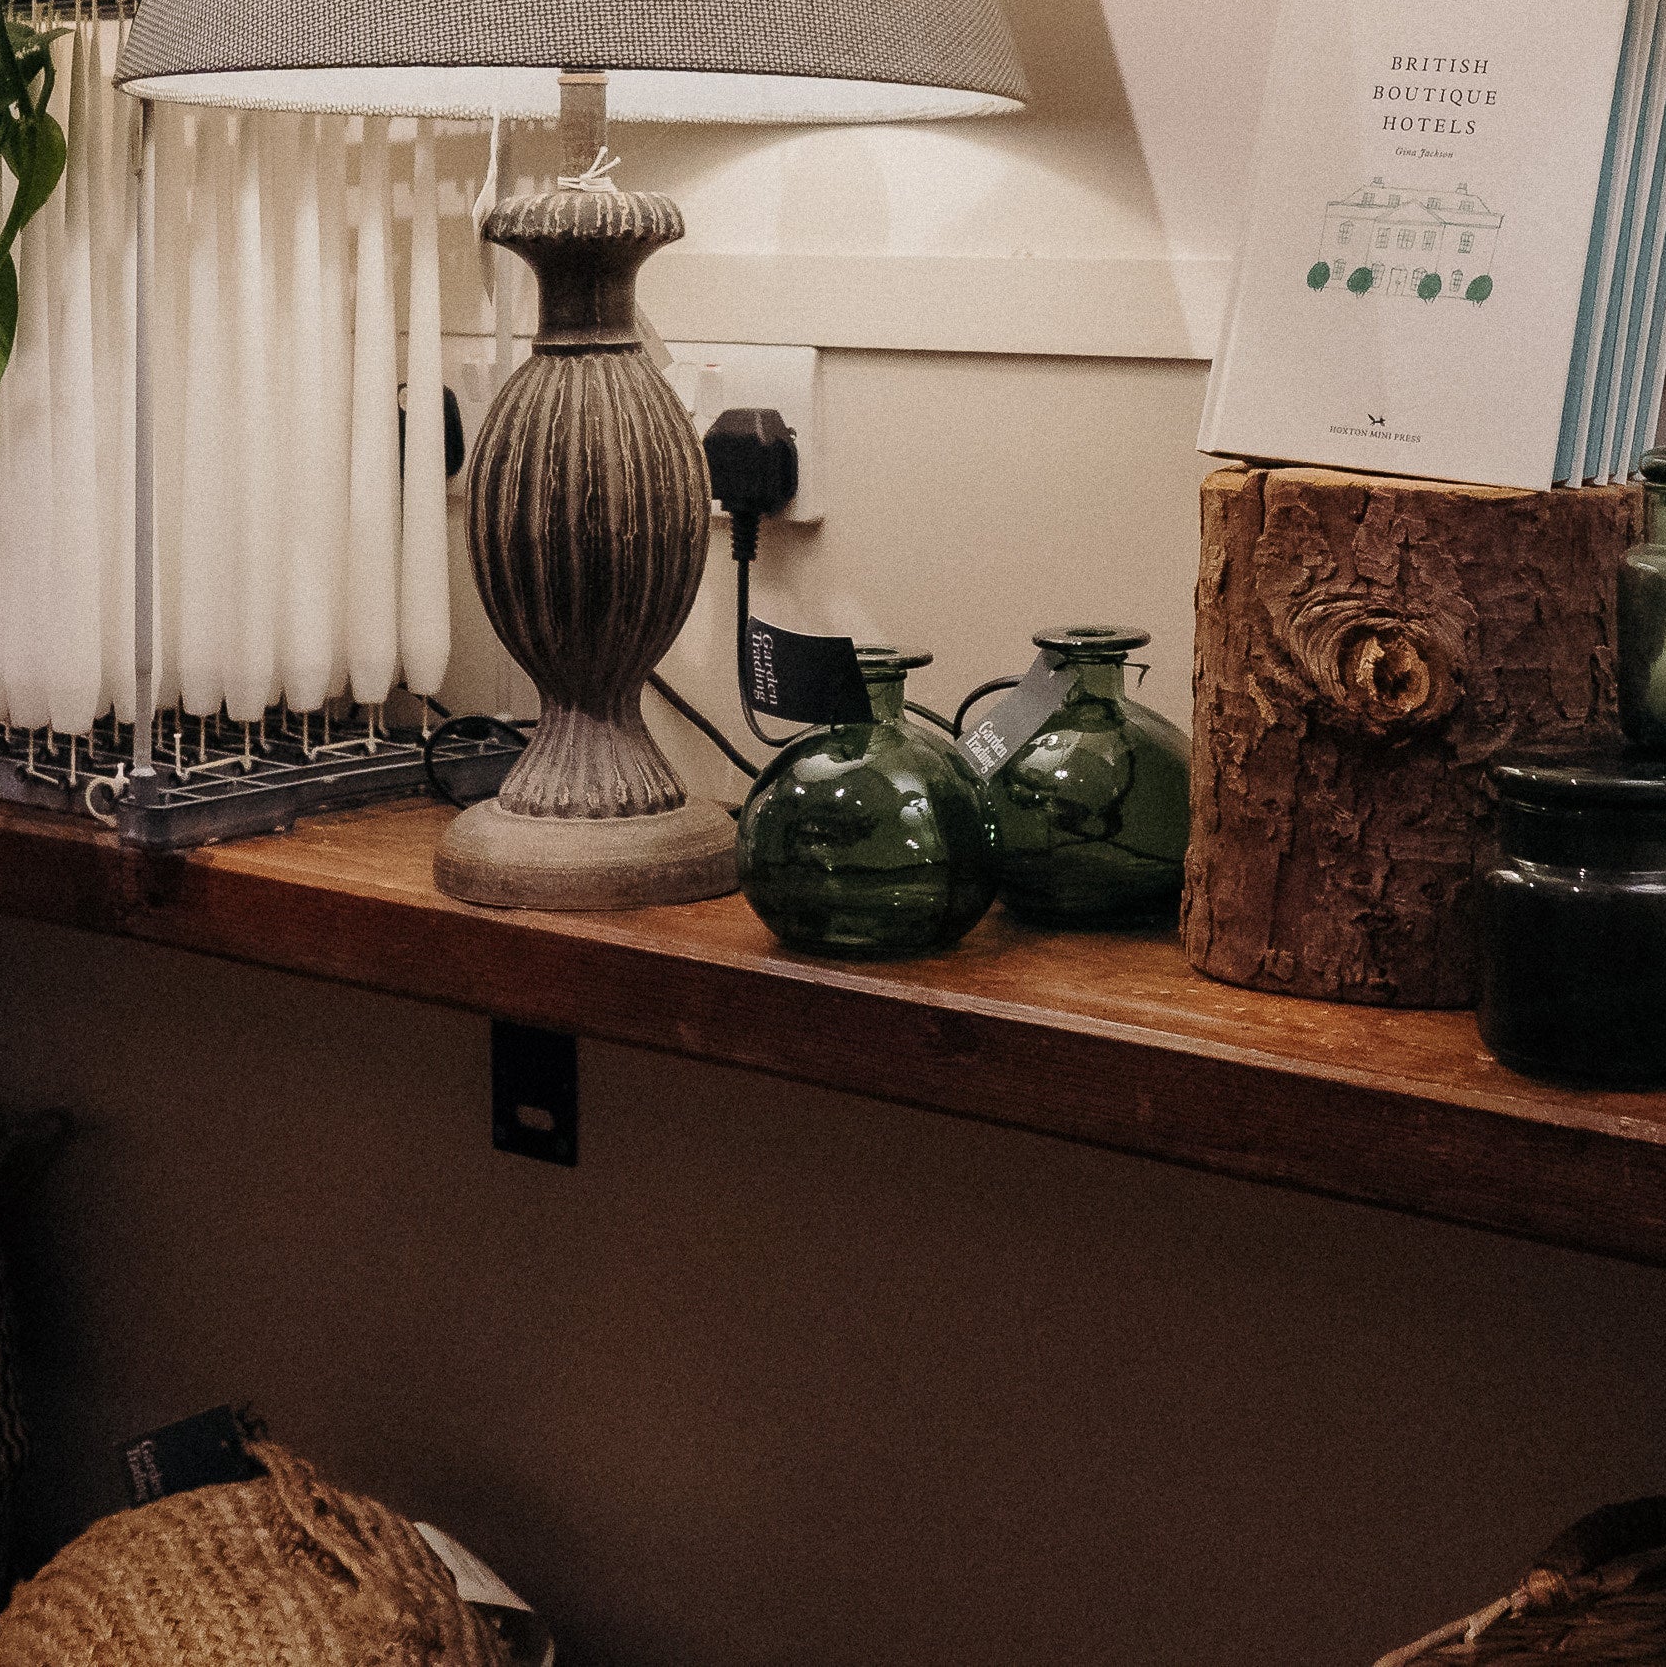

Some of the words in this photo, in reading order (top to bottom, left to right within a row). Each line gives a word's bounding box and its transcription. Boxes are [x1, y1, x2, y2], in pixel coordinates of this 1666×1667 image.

[1390, 56, 1489, 74] BRITISH
[1372, 85, 1498, 106] BOUTIQUE
[1382, 115, 1477, 135] HOTELS
[1395, 147, 1417, 157] Gina
[1418, 148, 1454, 159] Jackson
[1329, 425, 1368, 437] HOXTON
[1369, 430, 1392, 440] MINI
[1393, 433, 1422, 443] PRESS
[752, 631, 766, 703] Trading
[762, 634, 779, 705] Garden
[978, 720, 1008, 758] Garden
[965, 730, 998, 774] Trading
